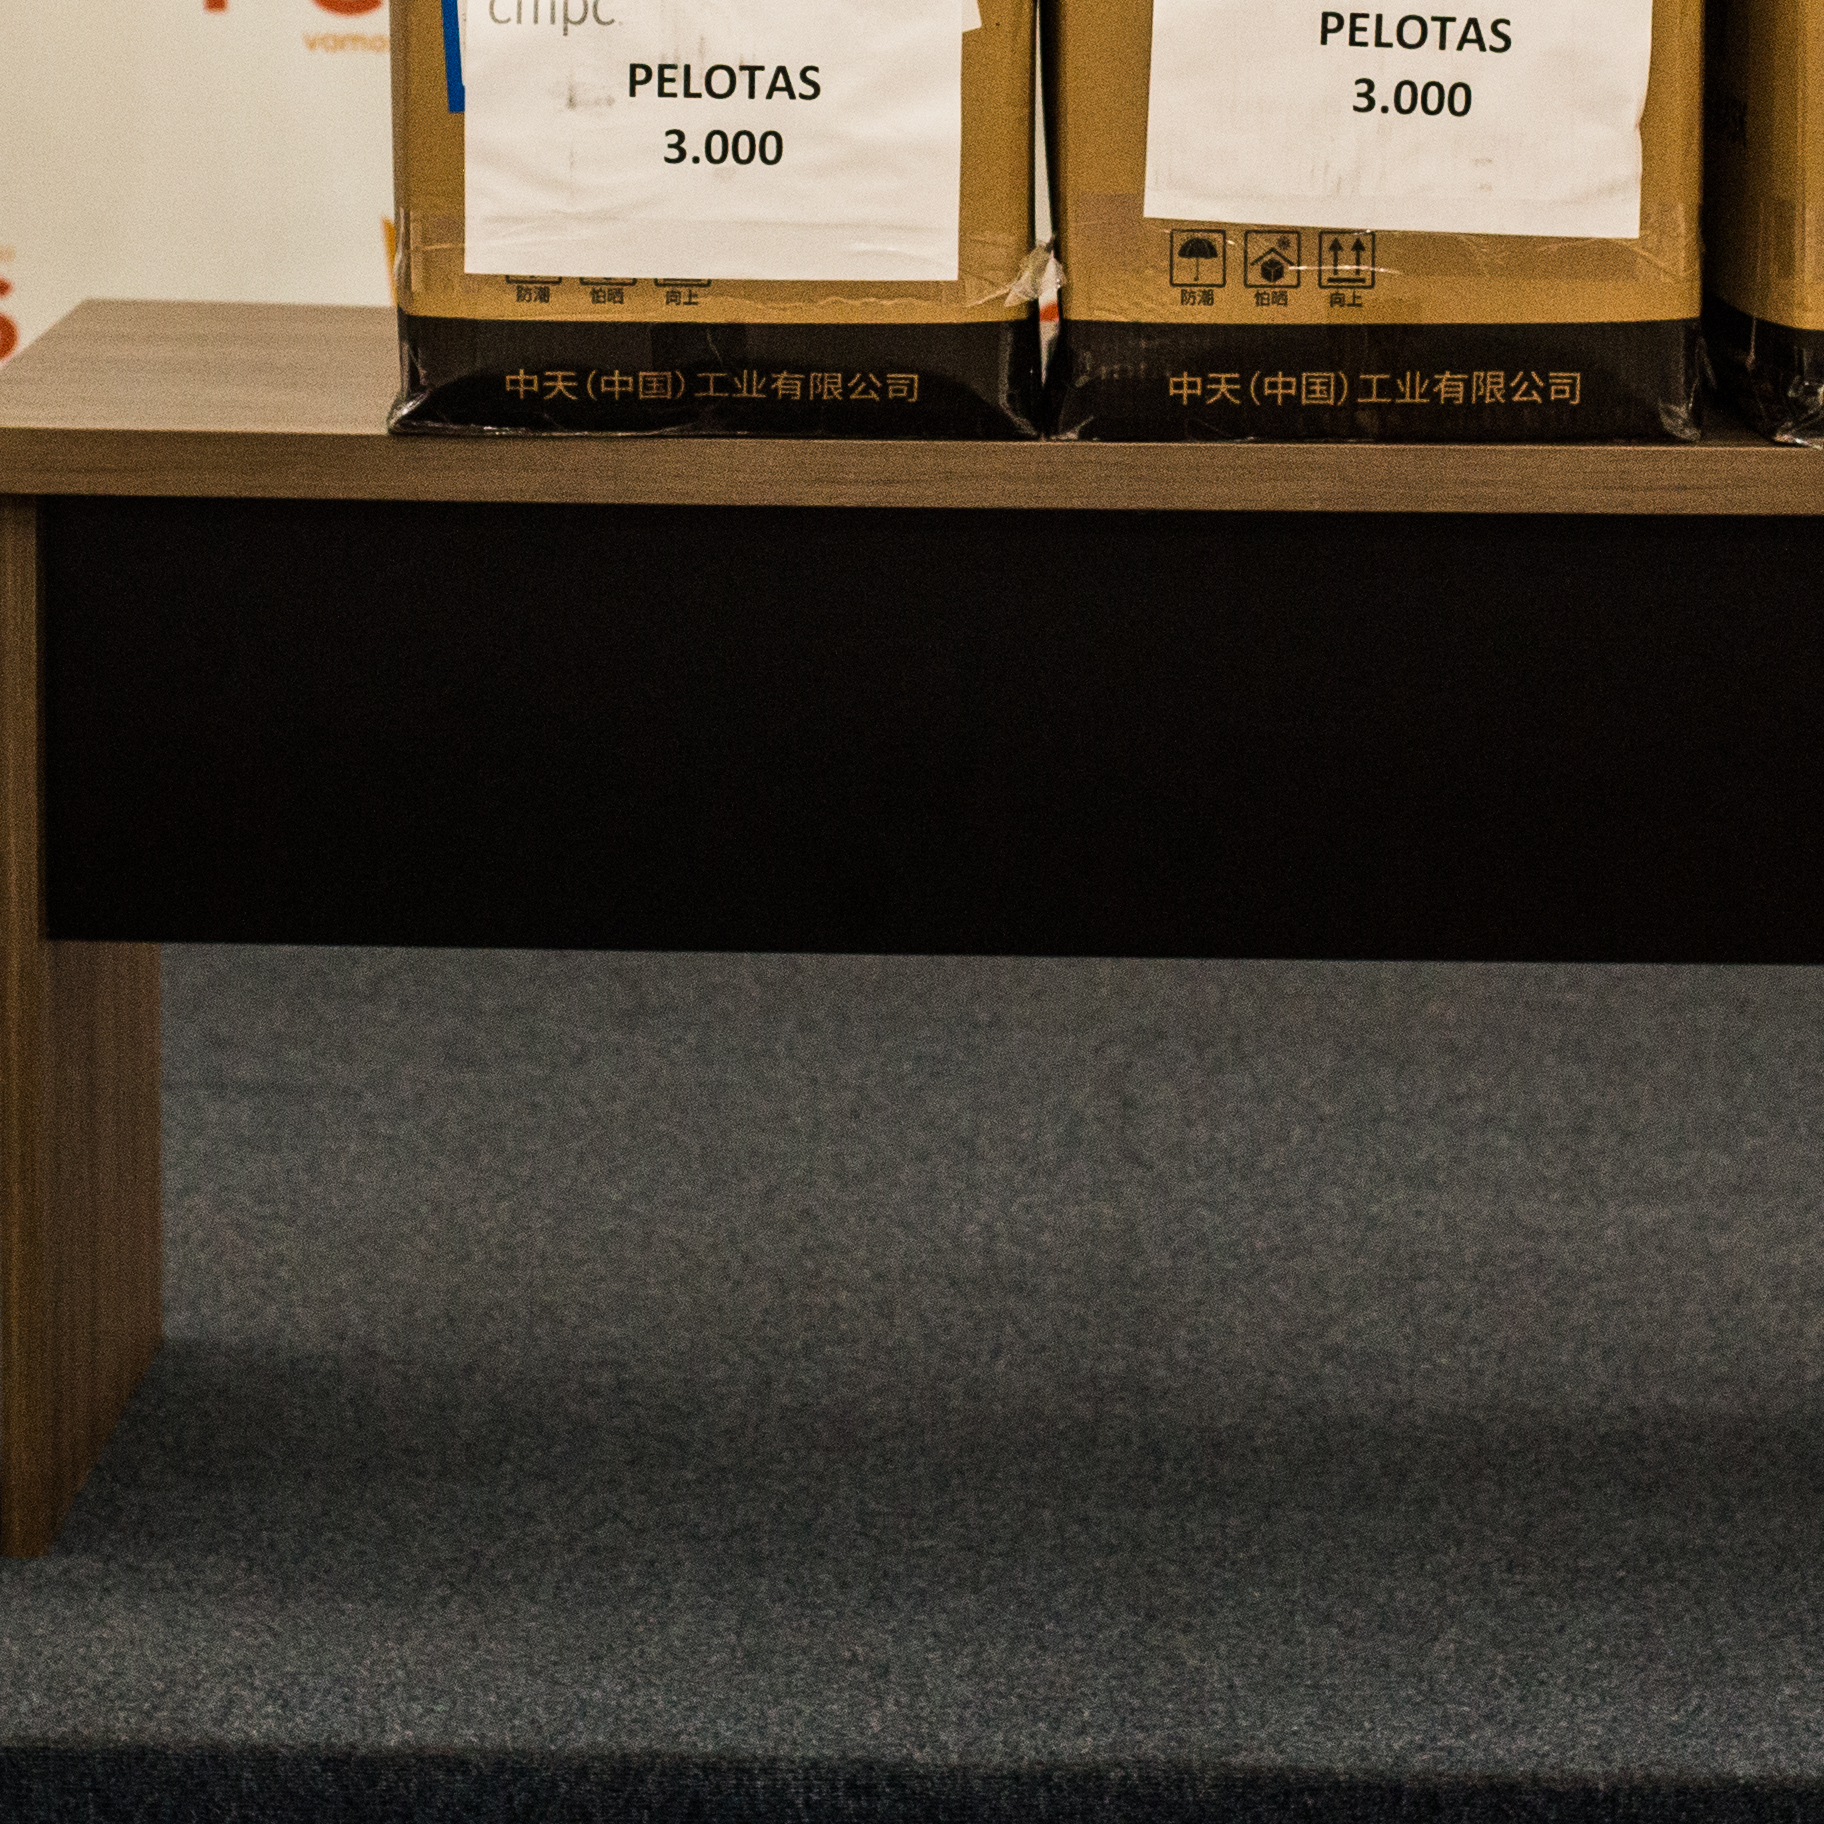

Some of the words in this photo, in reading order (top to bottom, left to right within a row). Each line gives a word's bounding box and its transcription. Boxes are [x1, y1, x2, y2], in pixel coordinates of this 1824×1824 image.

[1319, 10, 1513, 54] PELOTAS
[304, 34, 389, 53] vamo
[628, 63, 821, 101] PELOTAS
[1352, 77, 1472, 118] 3.000
[664, 129, 783, 166] 3.000
[515, 286, 551, 305] 防潮
[590, 287, 625, 306] 怕晒
[665, 289, 700, 307] 向上
[1180, 288, 1215, 307] 防潮
[1253, 288, 1288, 307] 怕晒
[1329, 290, 1363, 308] 向上
